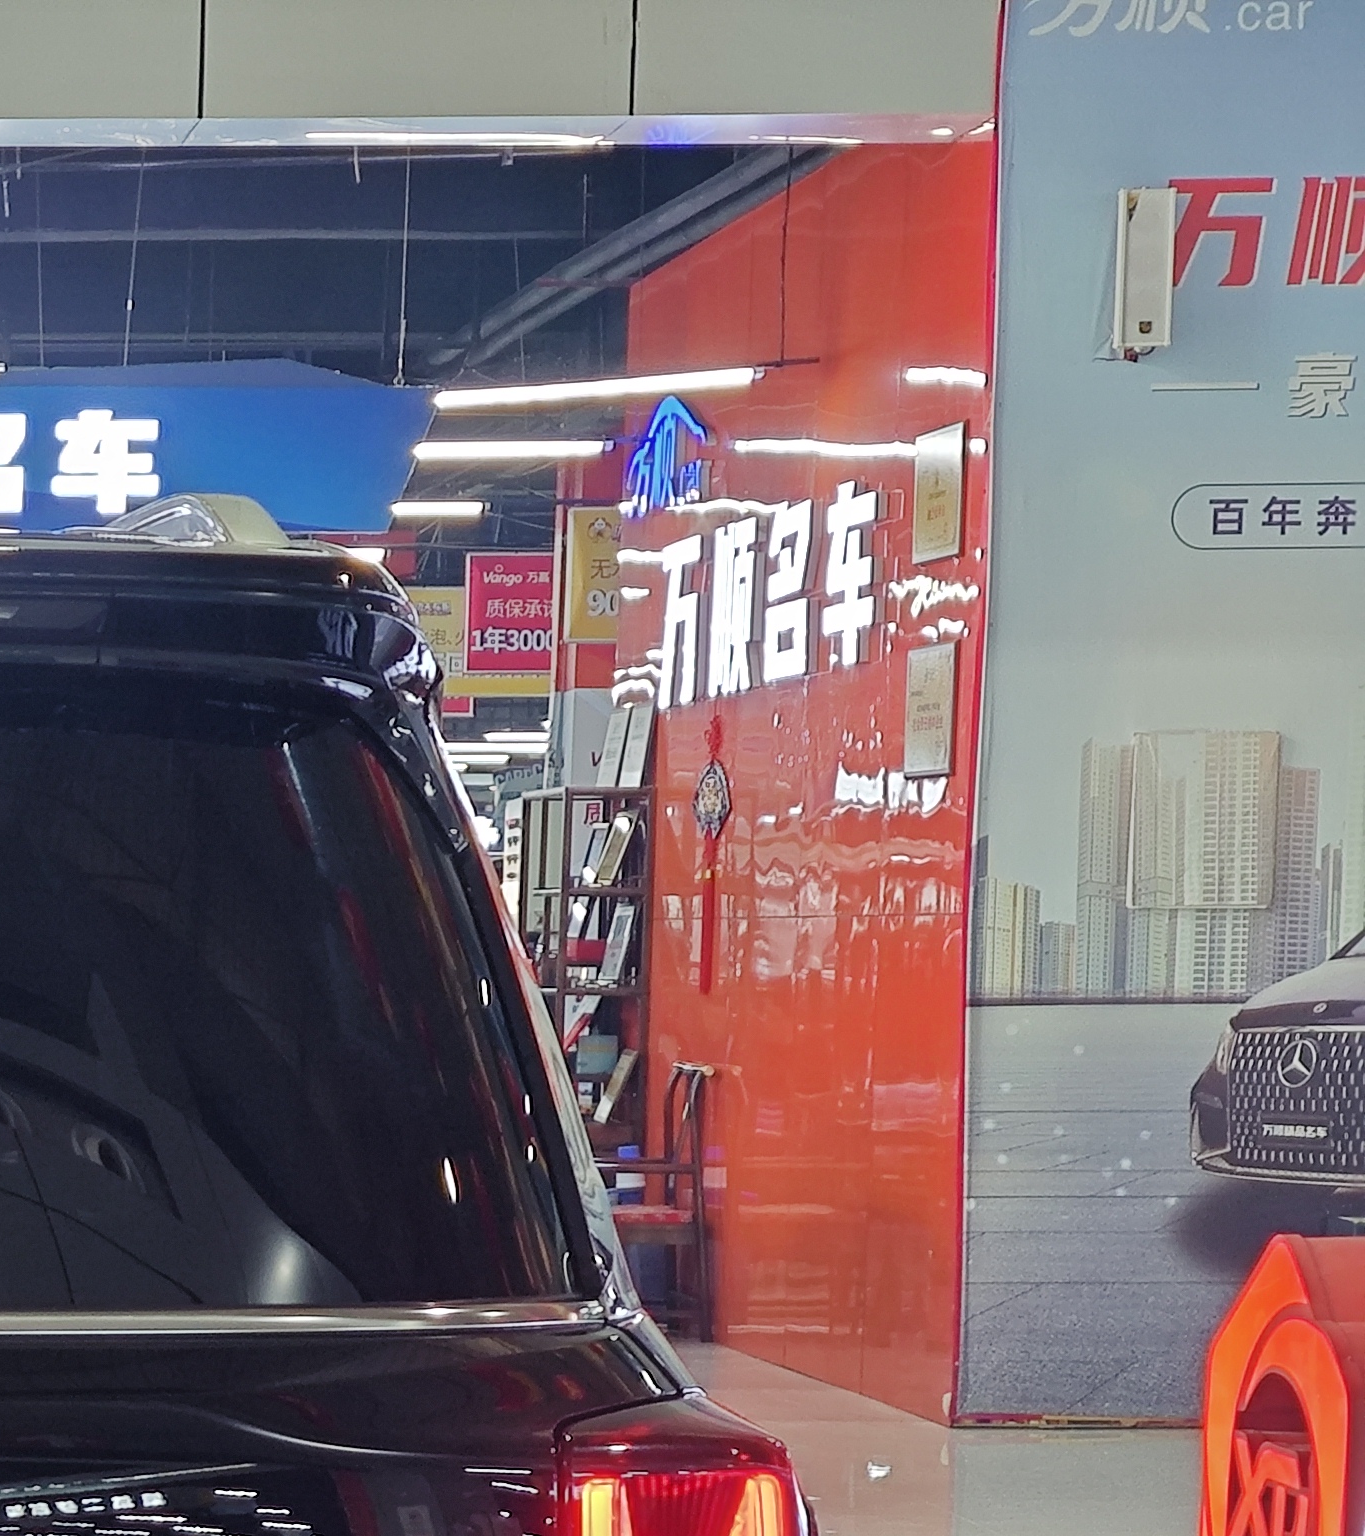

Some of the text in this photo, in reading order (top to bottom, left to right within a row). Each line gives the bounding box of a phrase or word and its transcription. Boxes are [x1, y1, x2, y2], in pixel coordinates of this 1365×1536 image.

[1287, 353, 1359, 419] 豪
[1208, 495, 1358, 537] 百年奔
[482, 566, 523, 587] Vango
[590, 558, 620, 580] 无
[656, 481, 880, 709] 万顺名车
